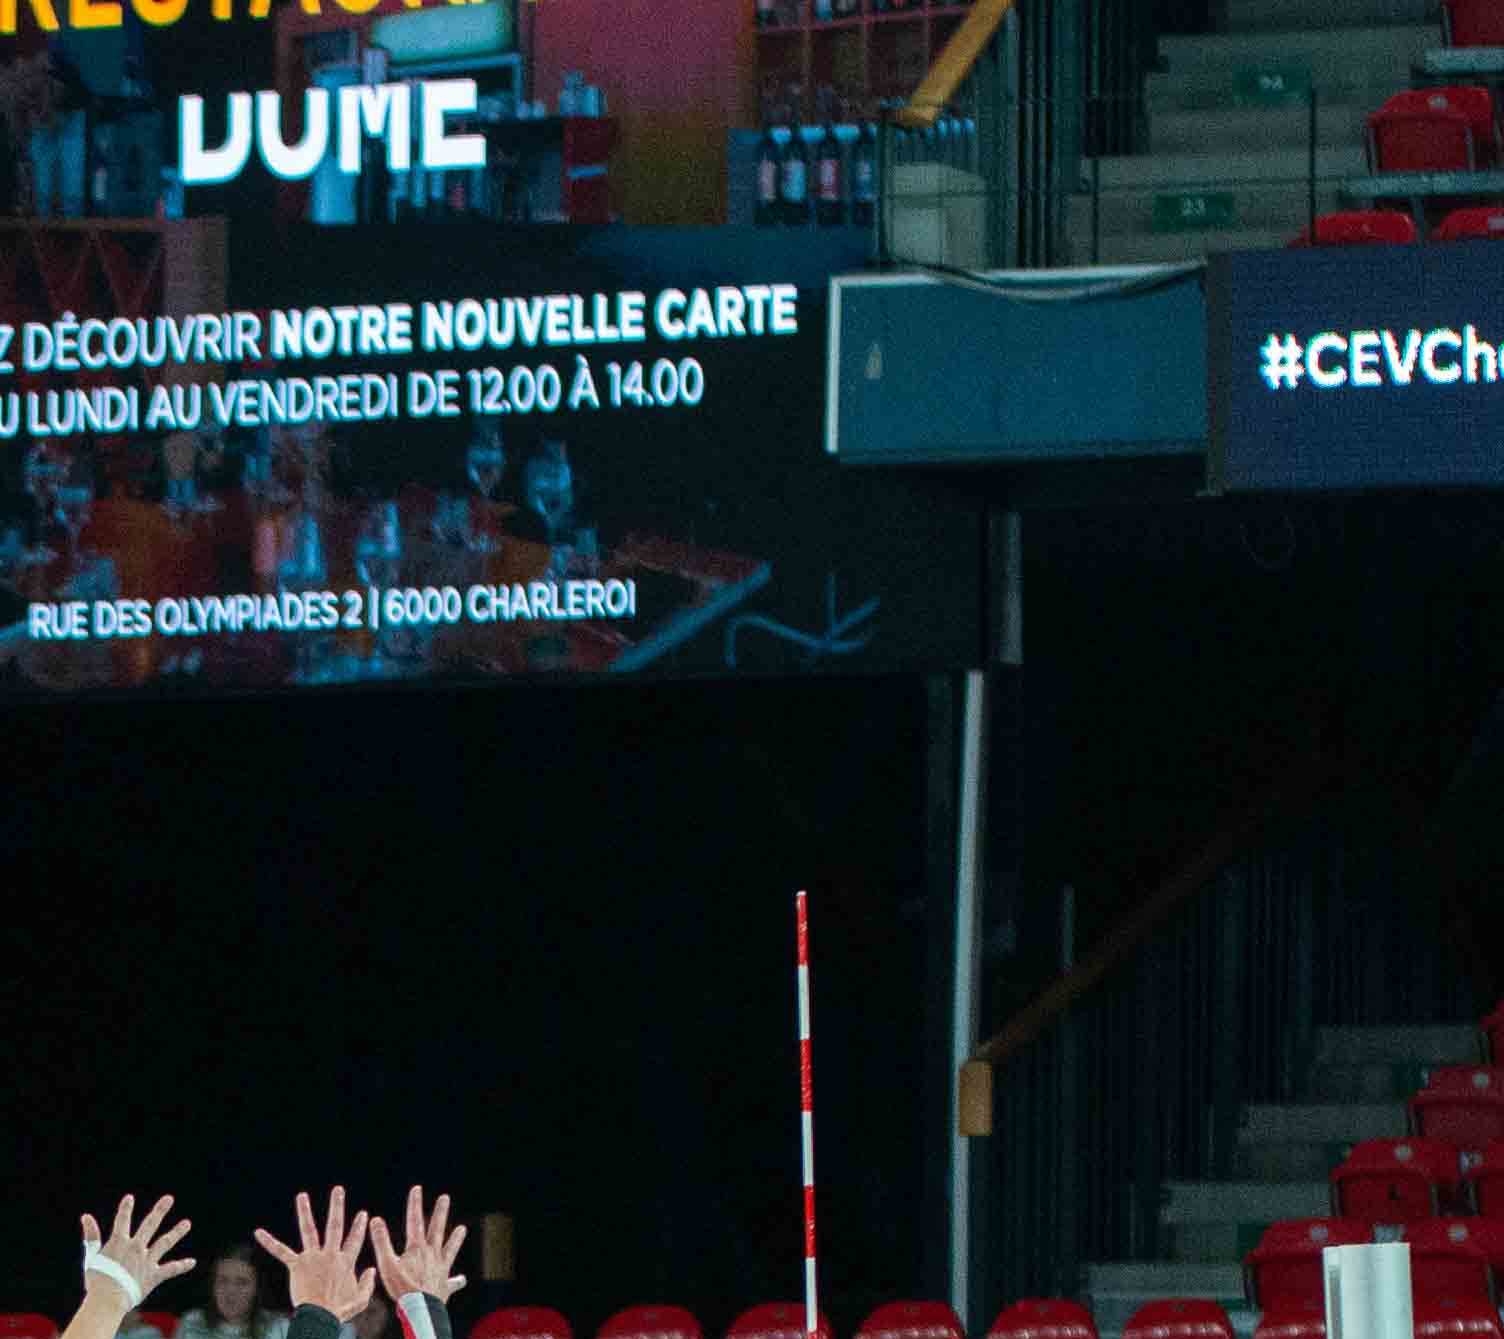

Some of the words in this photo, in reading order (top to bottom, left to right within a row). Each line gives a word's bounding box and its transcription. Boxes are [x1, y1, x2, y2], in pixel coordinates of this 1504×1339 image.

[22, 311, 262, 372] DÉCOUVRIR
[270, 304, 413, 359] NOTRE
[422, 292, 646, 351] NOUVELLE
[654, 284, 798, 340] CARTE
[26, 386, 138, 436] LUNDI
[145, 383, 201, 431] AU
[207, 373, 398, 428] VENDREDI
[407, 370, 461, 418] DE
[567, 354, 601, 410] À
[28, 601, 89, 641] RUE
[94, 597, 152, 638] DES
[157, 590, 339, 637] OLYMPIADES
[344, 590, 363, 629] 2
[386, 585, 463, 625] 6000
[468, 578, 637, 622] CHARLEROI
